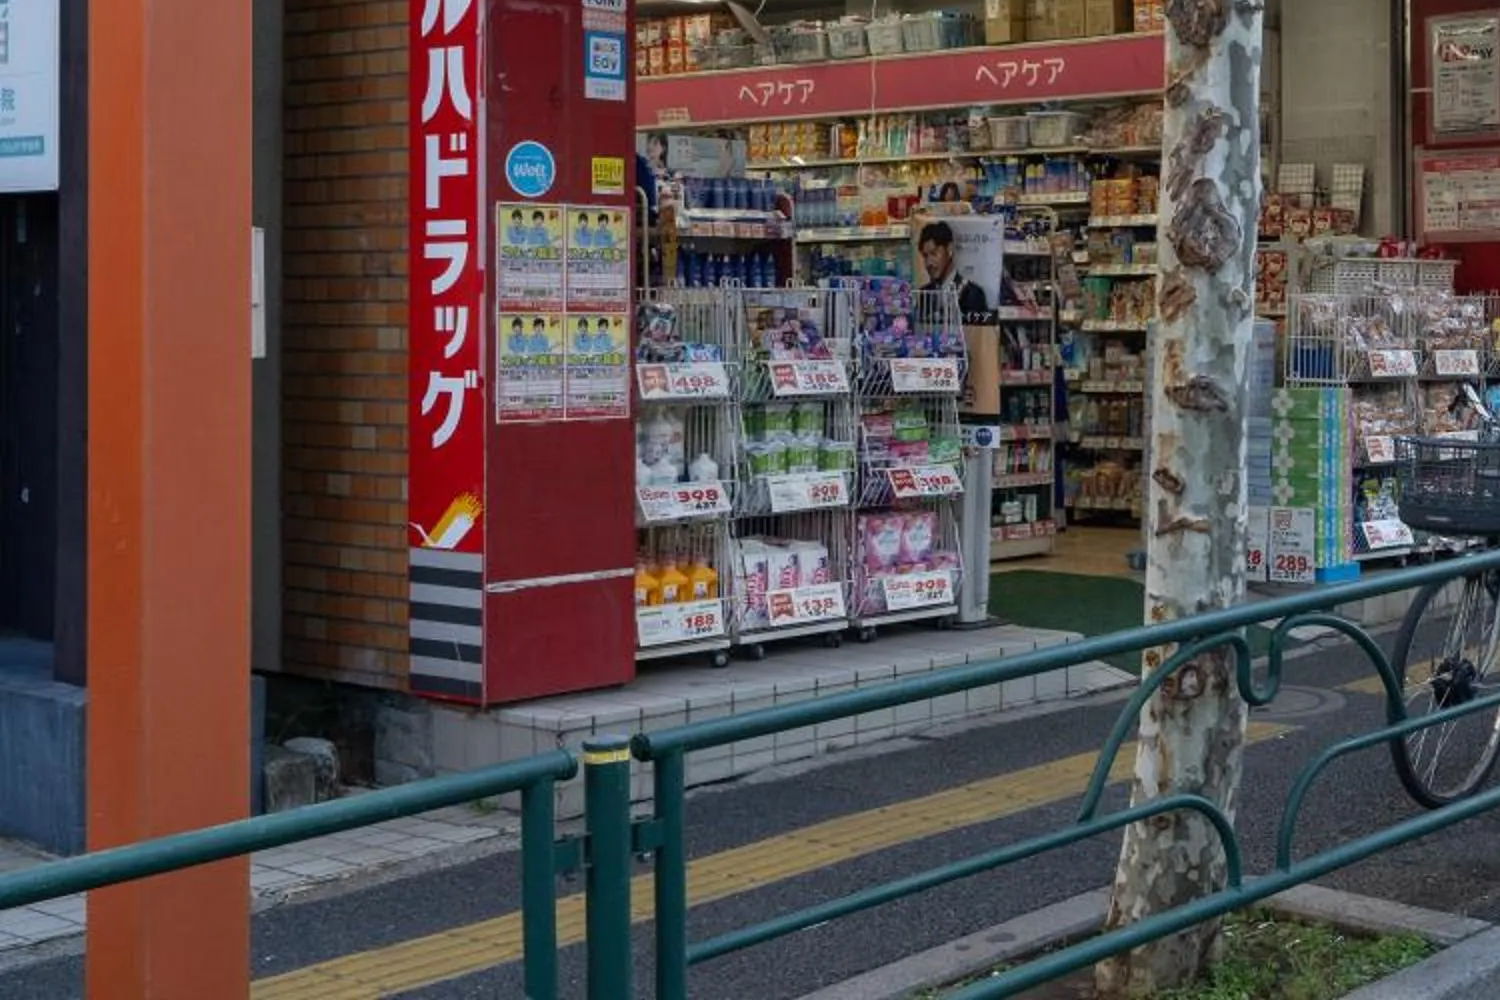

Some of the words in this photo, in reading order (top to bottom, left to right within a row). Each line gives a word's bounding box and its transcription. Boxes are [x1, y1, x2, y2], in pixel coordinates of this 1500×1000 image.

[975, 58, 1065, 88] ヘアケア
[739, 79, 815, 107] ヘアケア
[1277, 554, 1307, 571] 289
